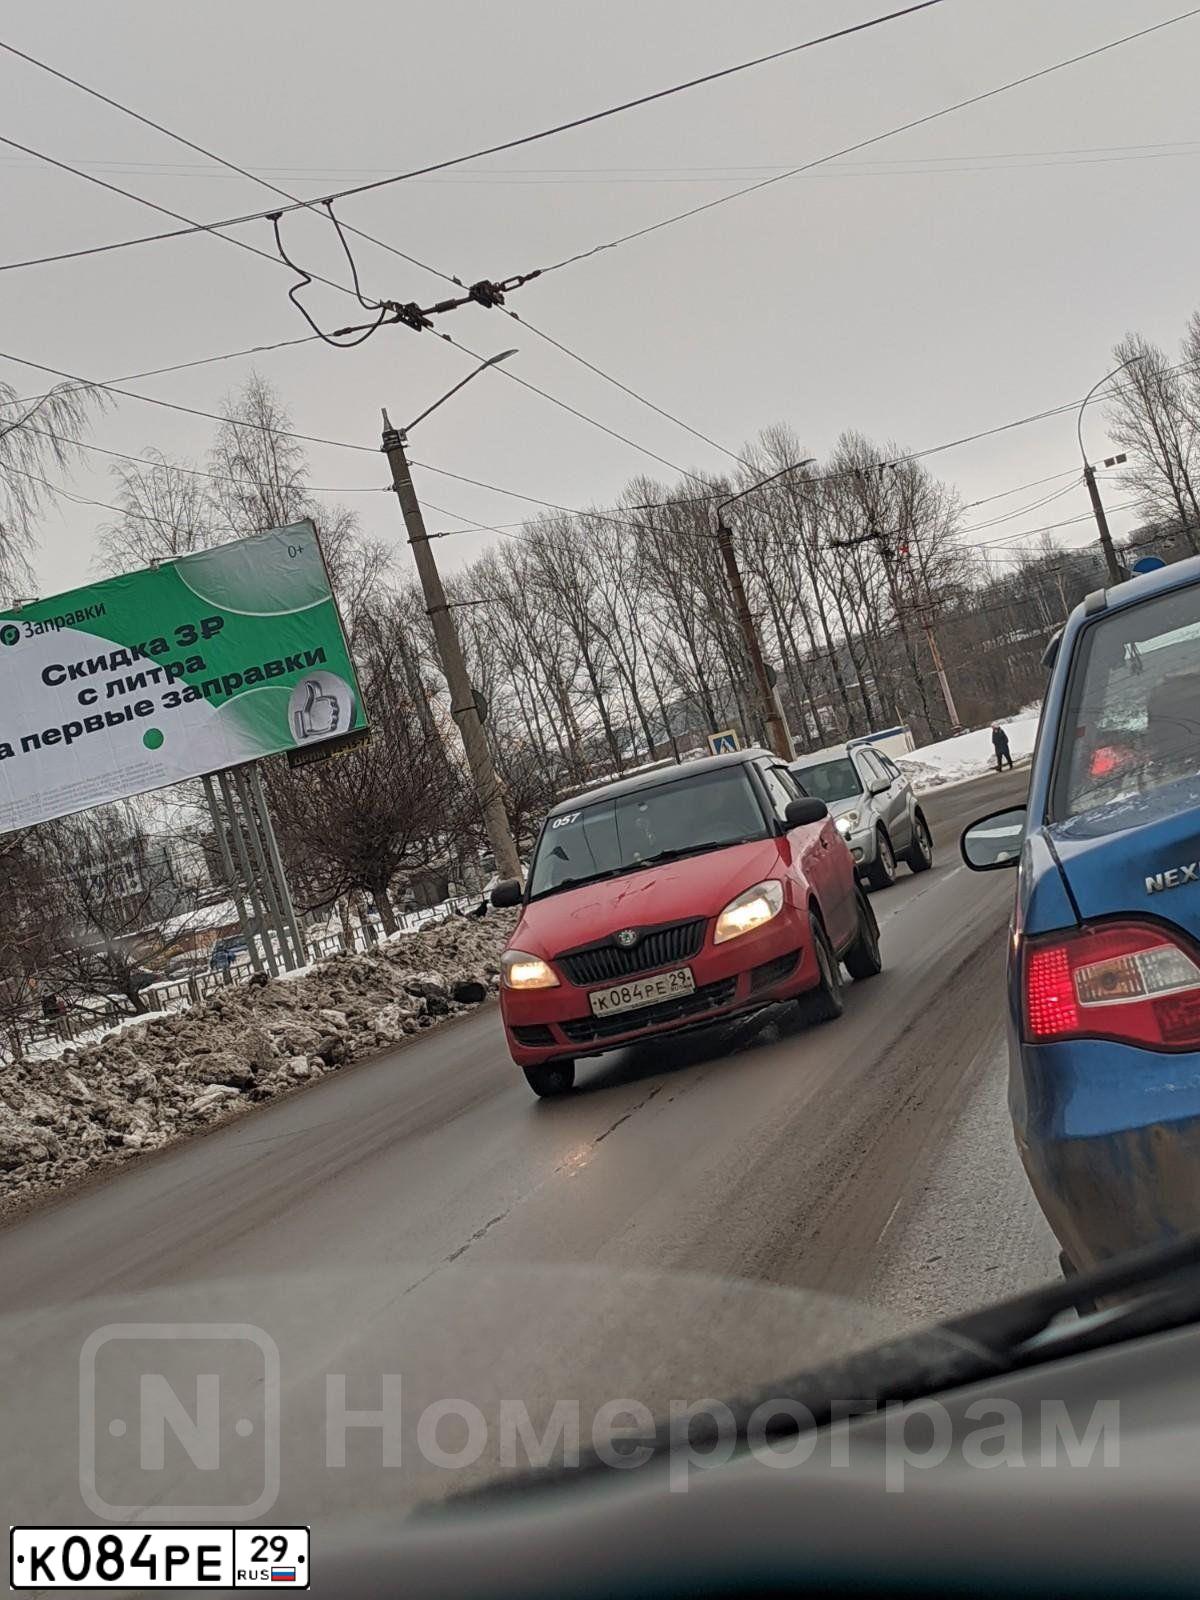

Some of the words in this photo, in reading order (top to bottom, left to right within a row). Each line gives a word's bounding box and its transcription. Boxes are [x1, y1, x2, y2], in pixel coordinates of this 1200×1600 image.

[287, 544, 304, 559] 0+
[22, 602, 106, 638] Заправки
[41, 636, 170, 687] Скидка
[77, 687, 98, 706] с
[106, 655, 206, 699] литра
[20, 699, 155, 753] первые
[161, 646, 328, 709] заправки
[552, 811, 582, 829] 057
[1145, 862, 1200, 894] NEX
[597, 980, 667, 1011] К084РЕ
[668, 971, 686, 987] 29
